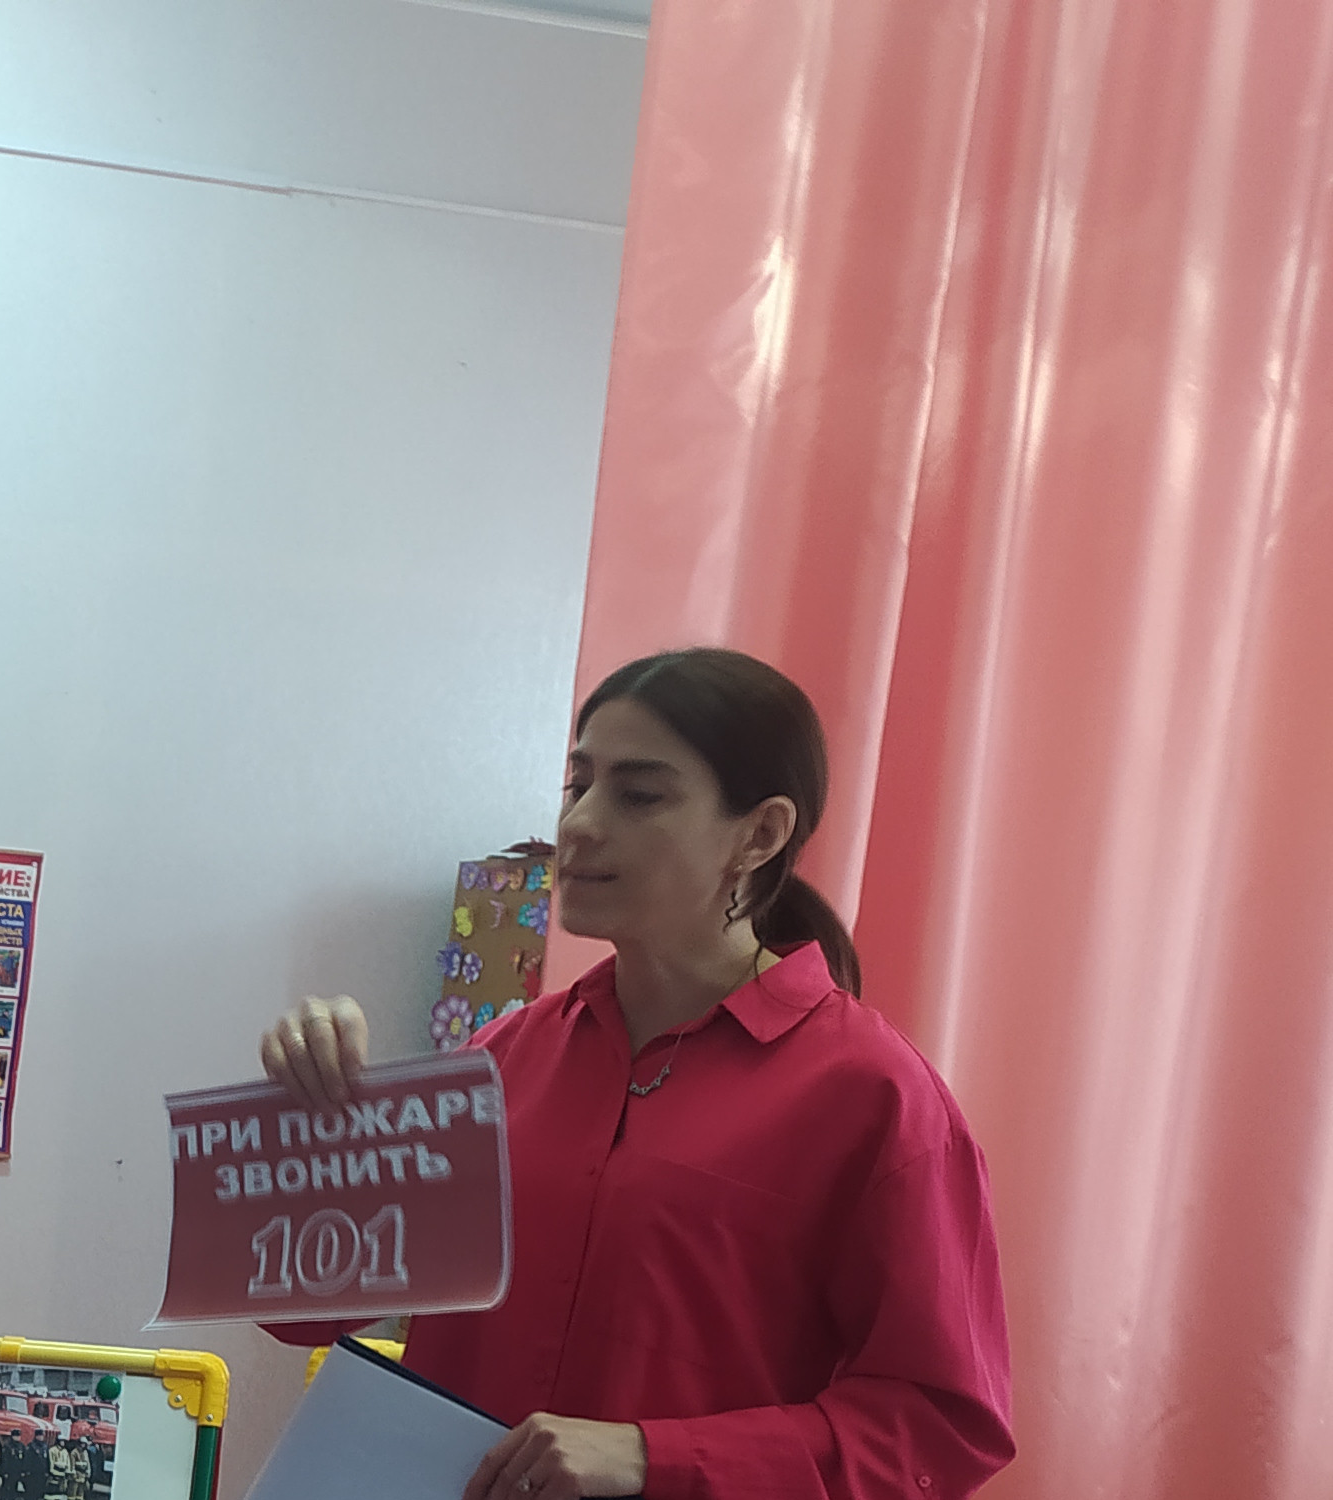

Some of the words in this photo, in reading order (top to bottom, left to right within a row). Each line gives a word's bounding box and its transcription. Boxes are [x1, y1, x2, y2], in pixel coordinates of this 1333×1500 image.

[171, 1117, 262, 1160] ПРИ
[279, 1084, 502, 1148] ПОЖАРЕ
[215, 1143, 453, 1201] ЗВОНИТЬ
[248, 1204, 410, 1299] 101
